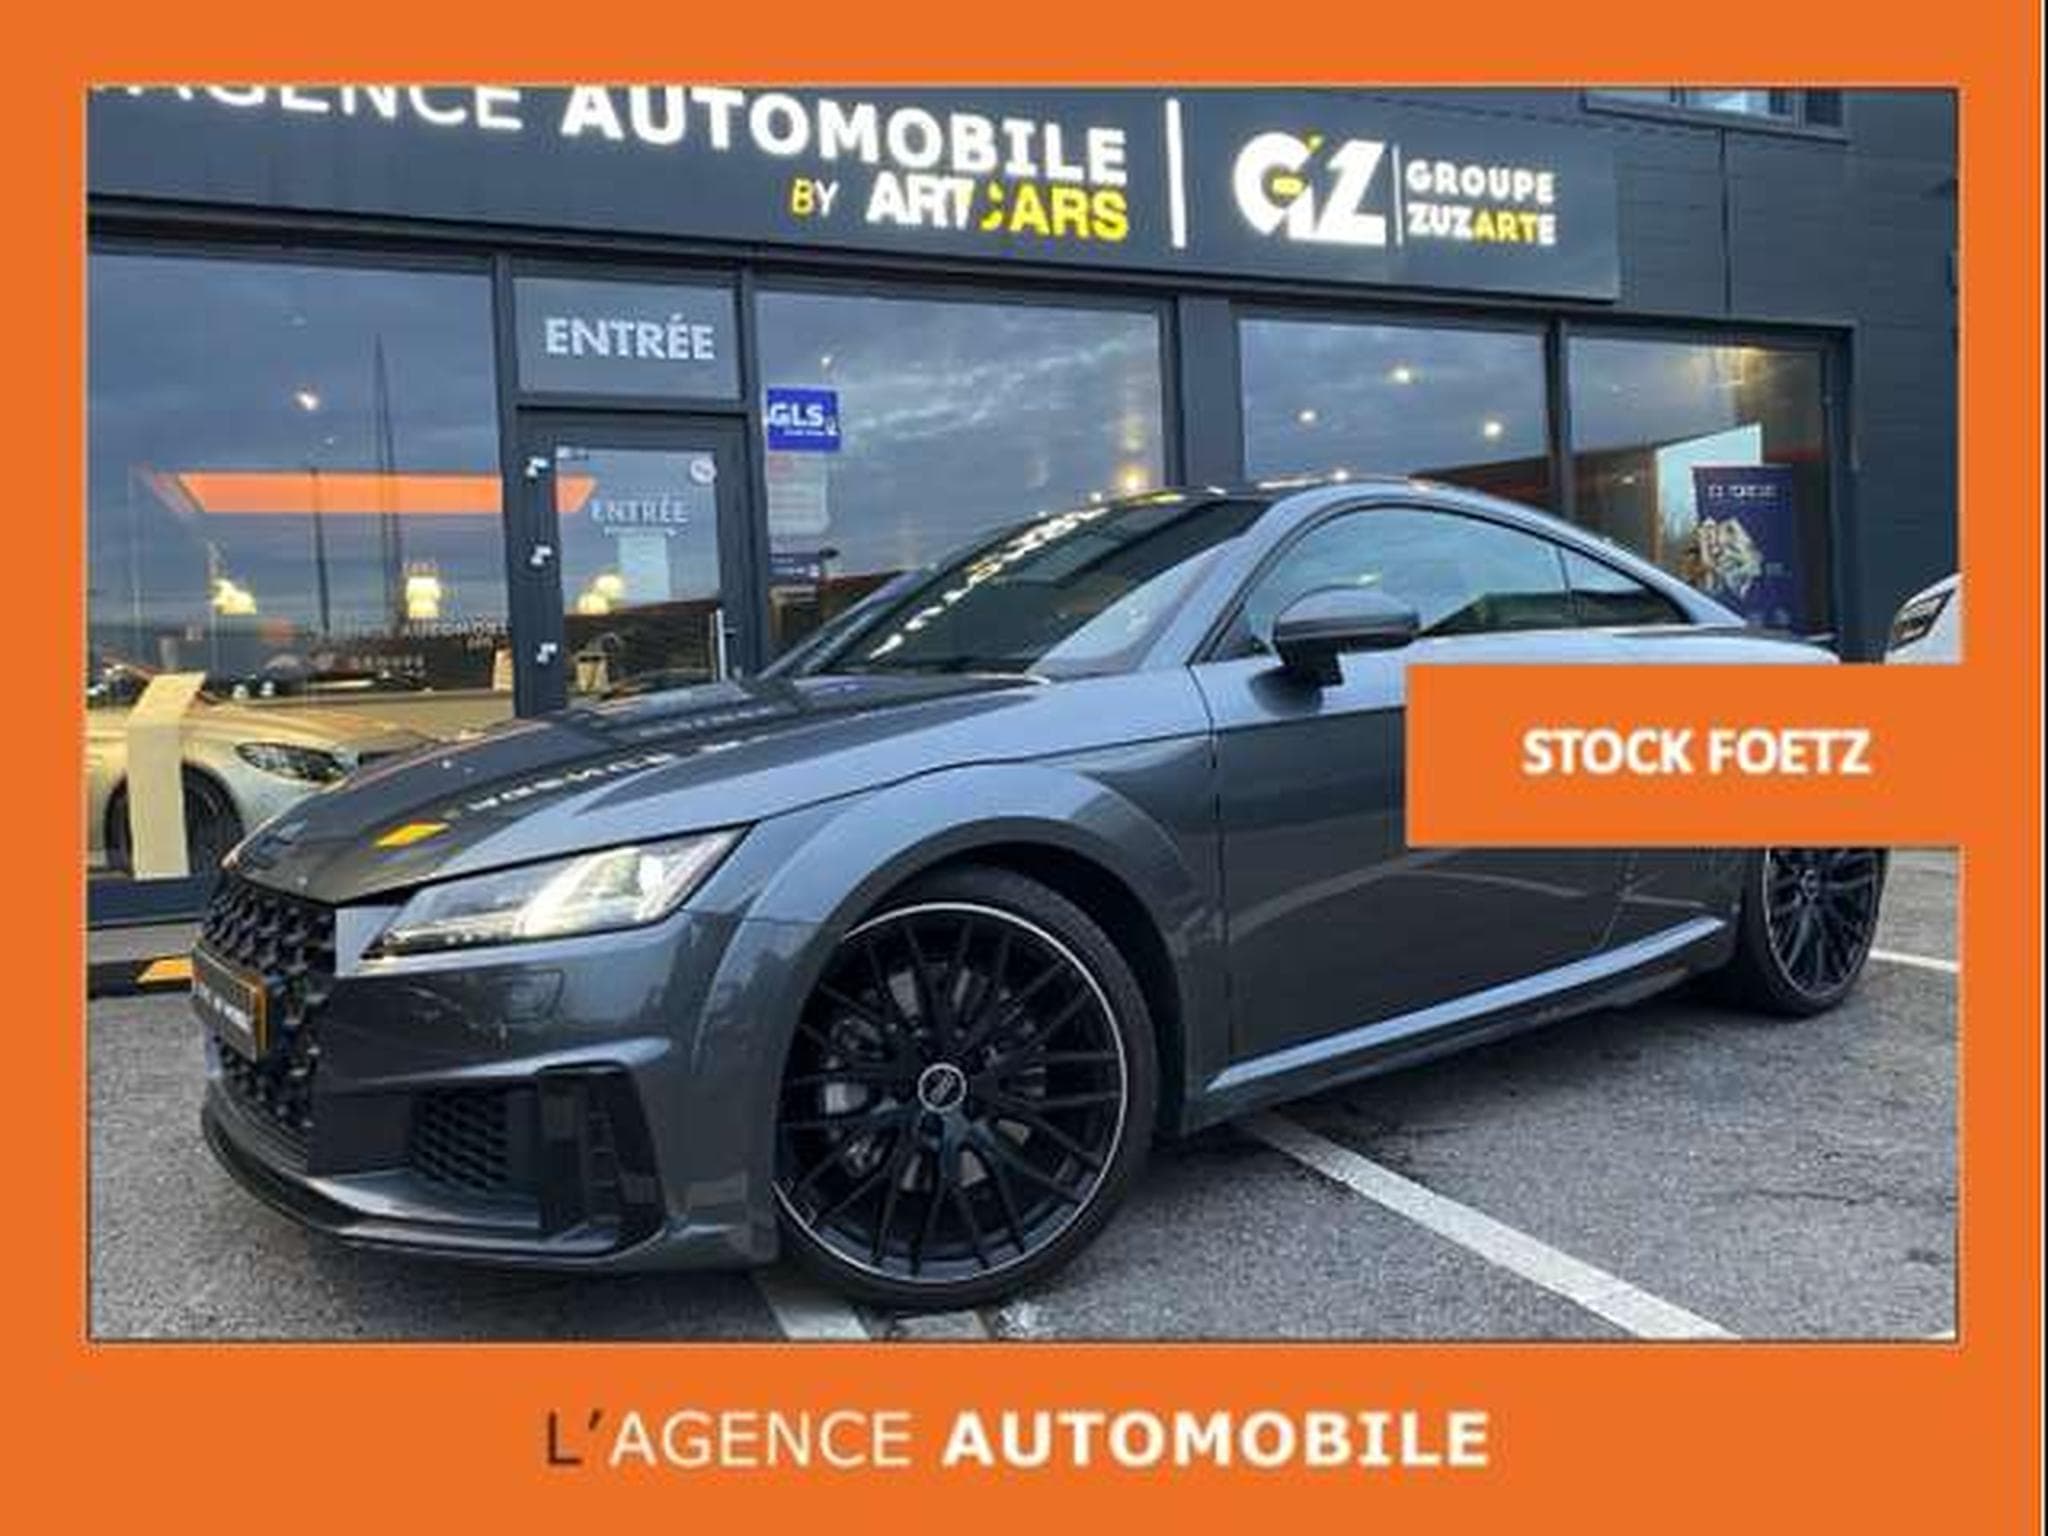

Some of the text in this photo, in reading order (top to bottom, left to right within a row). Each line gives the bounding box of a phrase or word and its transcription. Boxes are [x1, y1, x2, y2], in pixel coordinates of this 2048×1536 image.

[561, 87, 1127, 186] AUTOMOBILE
[791, 178, 838, 217] BY
[1406, 158, 1555, 202] GROUPE
[1407, 203, 1557, 246] ZUZARTE
[545, 313, 715, 361] ENTRÉE
[768, 402, 824, 428] GLS
